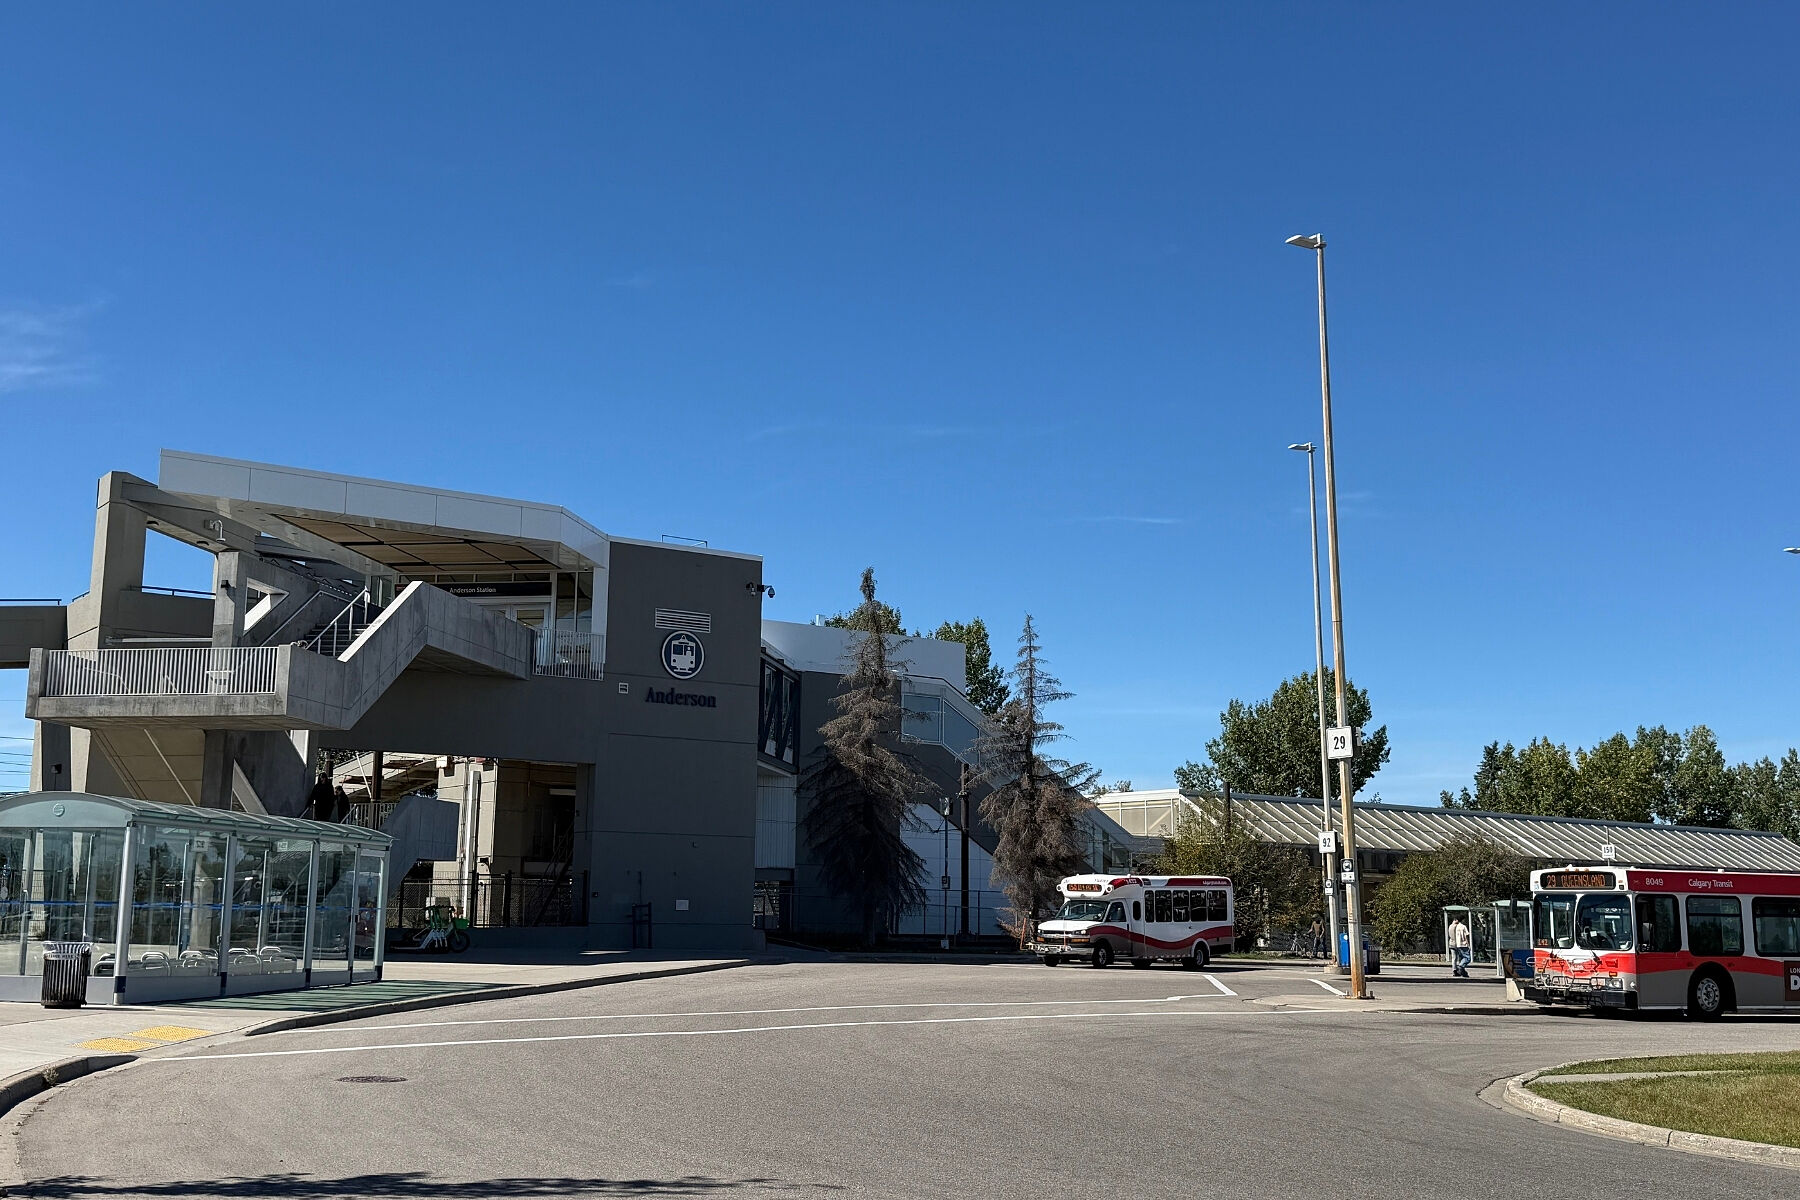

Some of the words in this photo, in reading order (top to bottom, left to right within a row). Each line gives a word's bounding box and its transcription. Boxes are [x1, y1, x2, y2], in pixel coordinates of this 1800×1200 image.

[645, 686, 717, 708] Anderson
[1333, 735, 1346, 750] 29
[1322, 837, 1331, 848] 92
[1546, 874, 1557, 888] 29
[1561, 874, 1606, 888] QUEENSLAND
[1645, 877, 1664, 886] 8049
[1688, 878, 1712, 889] Calgary
[1712, 879, 1733, 888] Transit
